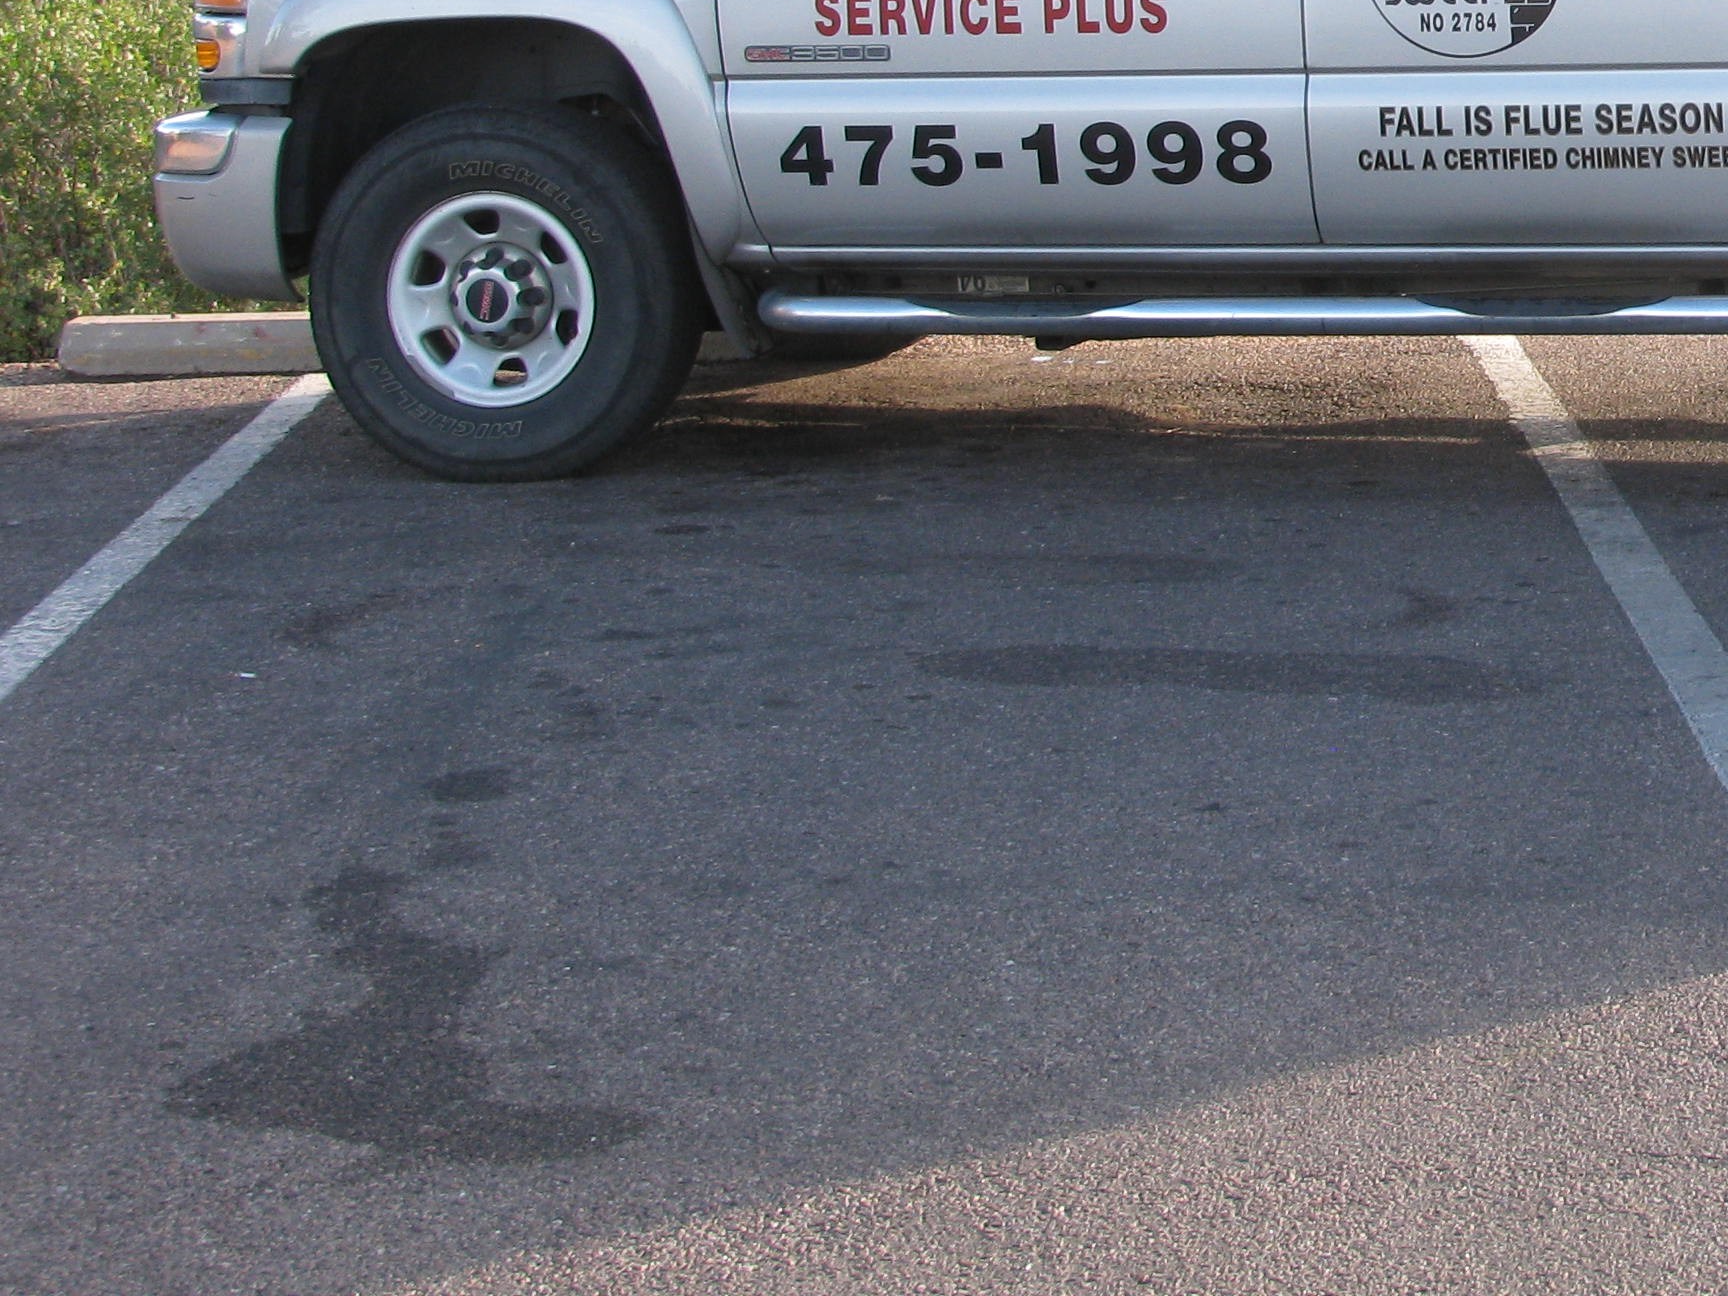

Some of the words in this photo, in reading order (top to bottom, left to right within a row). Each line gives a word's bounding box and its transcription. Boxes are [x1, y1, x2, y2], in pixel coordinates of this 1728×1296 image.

[1420, 12, 1445, 33] NO
[1451, 12, 1497, 32] 2784
[1378, 105, 1453, 138] FALL
[1464, 104, 1494, 137] IS
[1504, 104, 1583, 136] FLUE
[1594, 102, 1725, 135] SEASON
[779, 119, 1273, 187] 475-1998
[1358, 148, 1420, 171] CALL
[1422, 148, 1438, 171] A
[1443, 147, 1558, 171] CERTIFIED
[1565, 146, 1666, 169] CHIMNEY
[448, 159, 603, 244] MICHELIN
